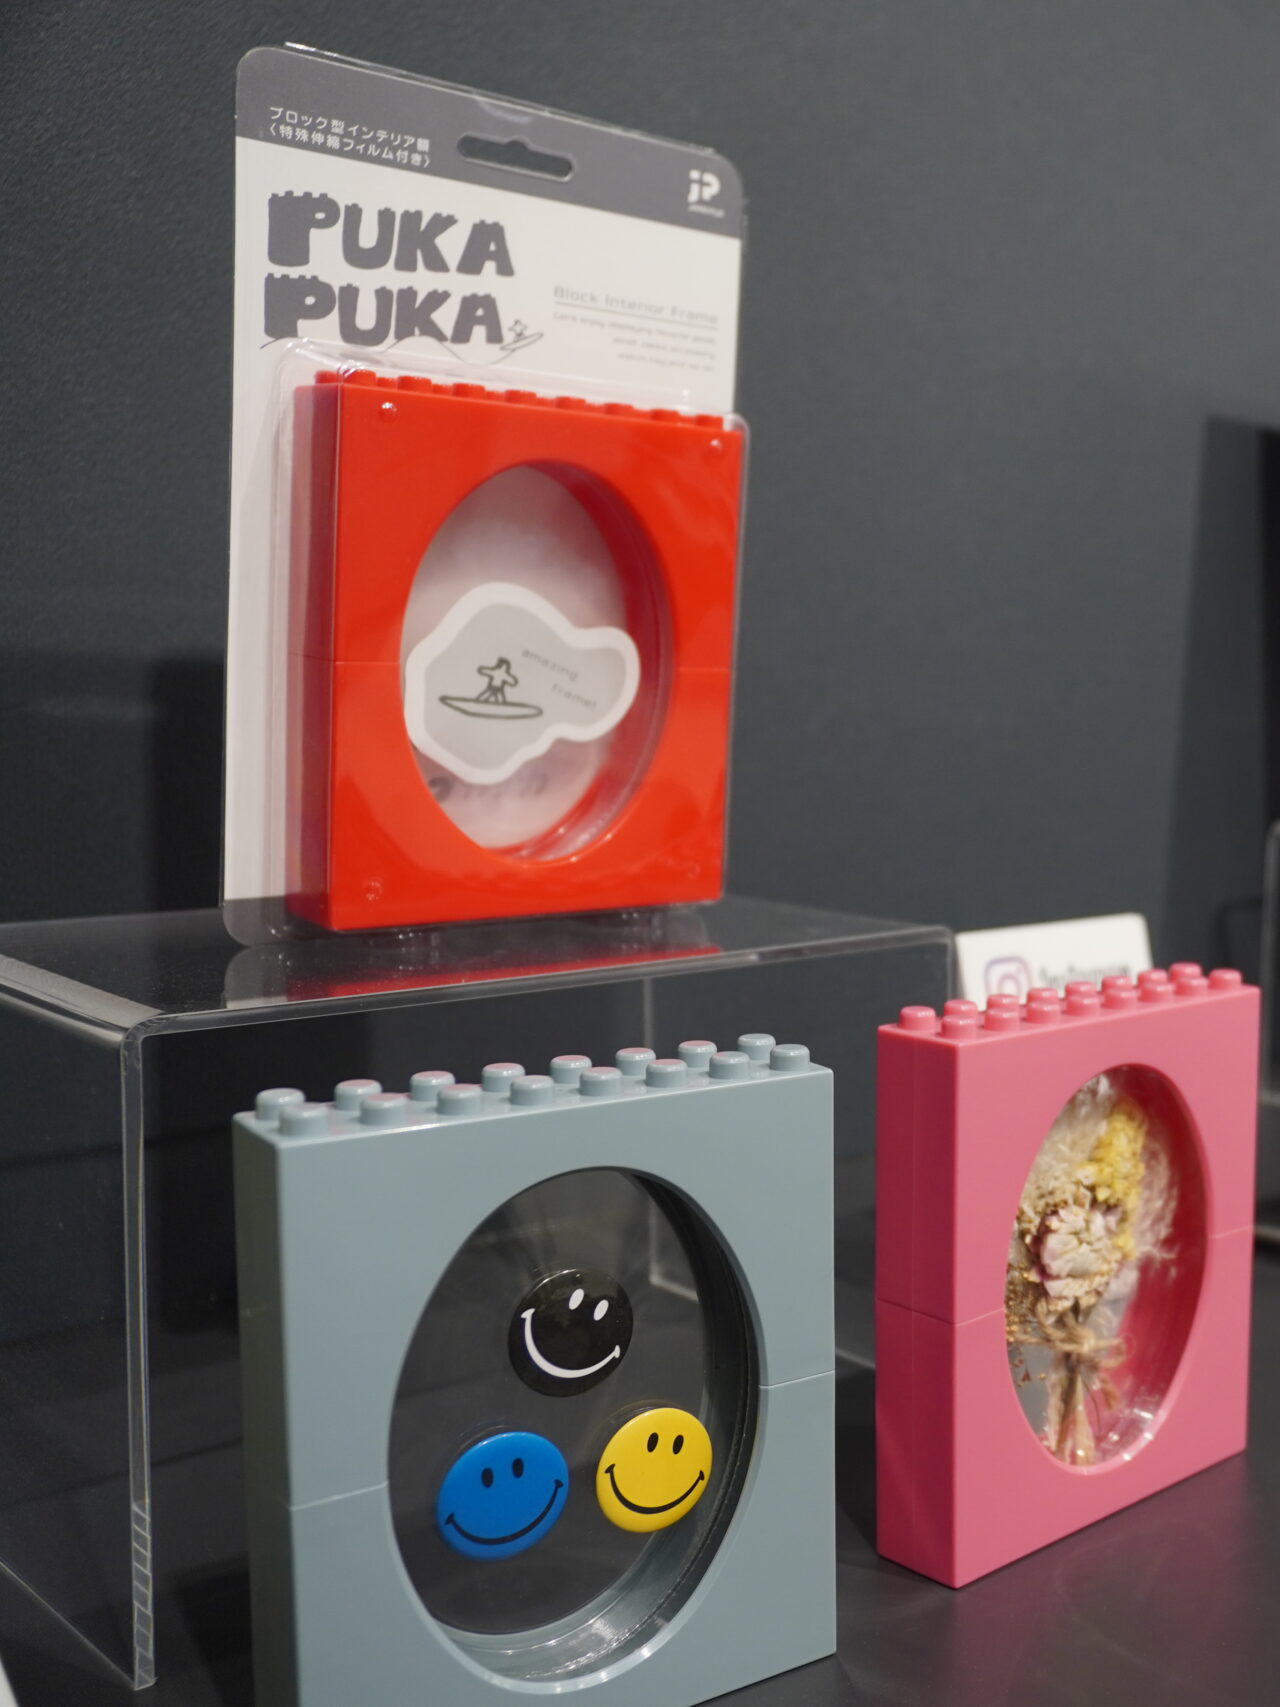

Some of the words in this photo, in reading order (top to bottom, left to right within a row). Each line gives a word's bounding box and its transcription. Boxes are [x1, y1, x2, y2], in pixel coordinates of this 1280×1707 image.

[267, 190, 515, 277] PUKA
[263, 272, 505, 347] PUKA
[553, 285, 599, 304] Block
[605, 293, 665, 315] Interior
[671, 305, 719, 324] Frame
[521, 648, 579, 682] amazing
